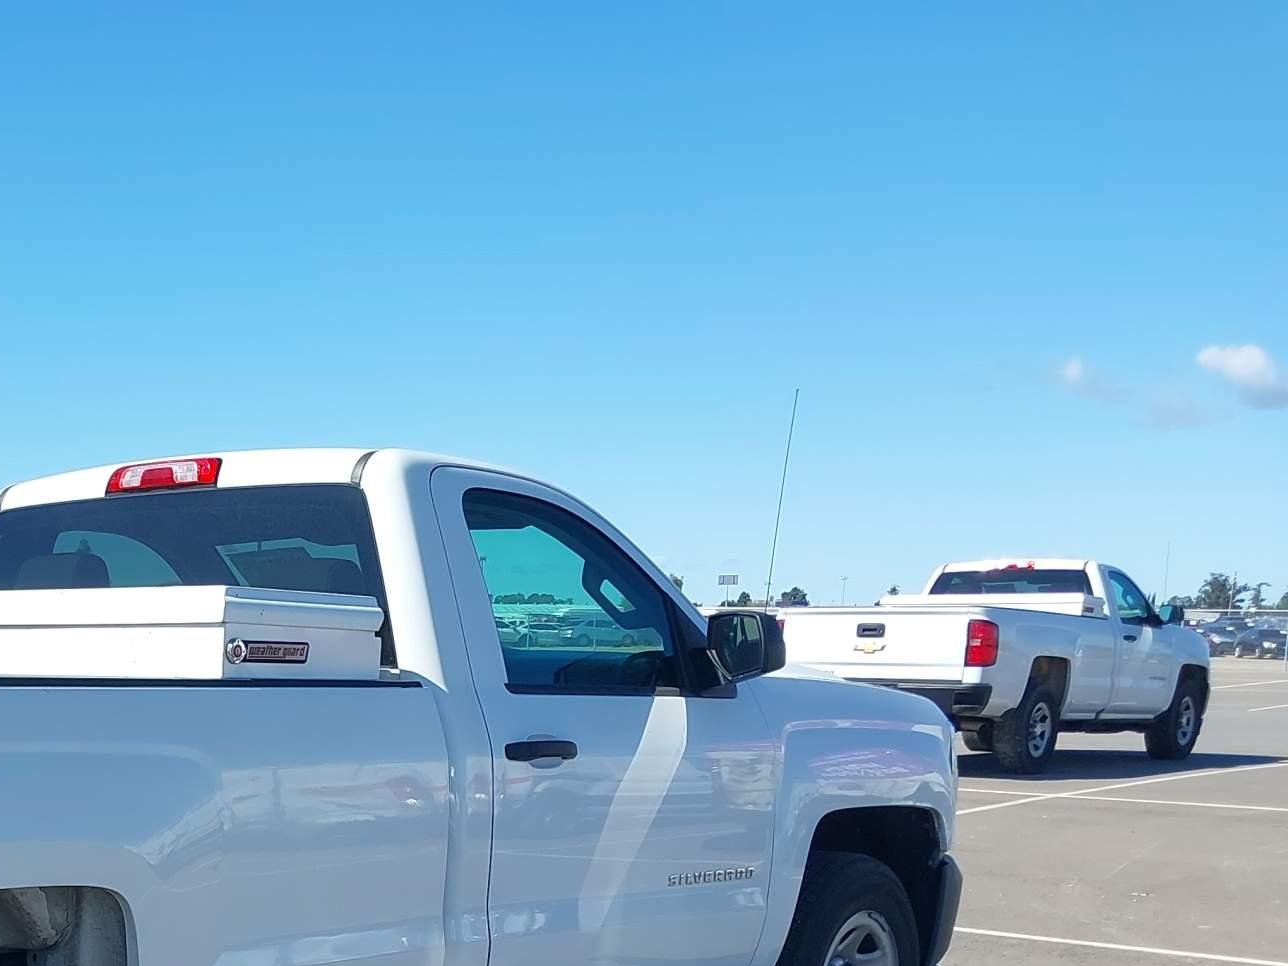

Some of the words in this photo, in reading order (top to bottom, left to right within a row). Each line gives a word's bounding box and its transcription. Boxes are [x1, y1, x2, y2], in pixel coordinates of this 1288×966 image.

[248, 645, 281, 657] weather
[283, 646, 306, 659] guard
[667, 867, 756, 887] SILVERADO
